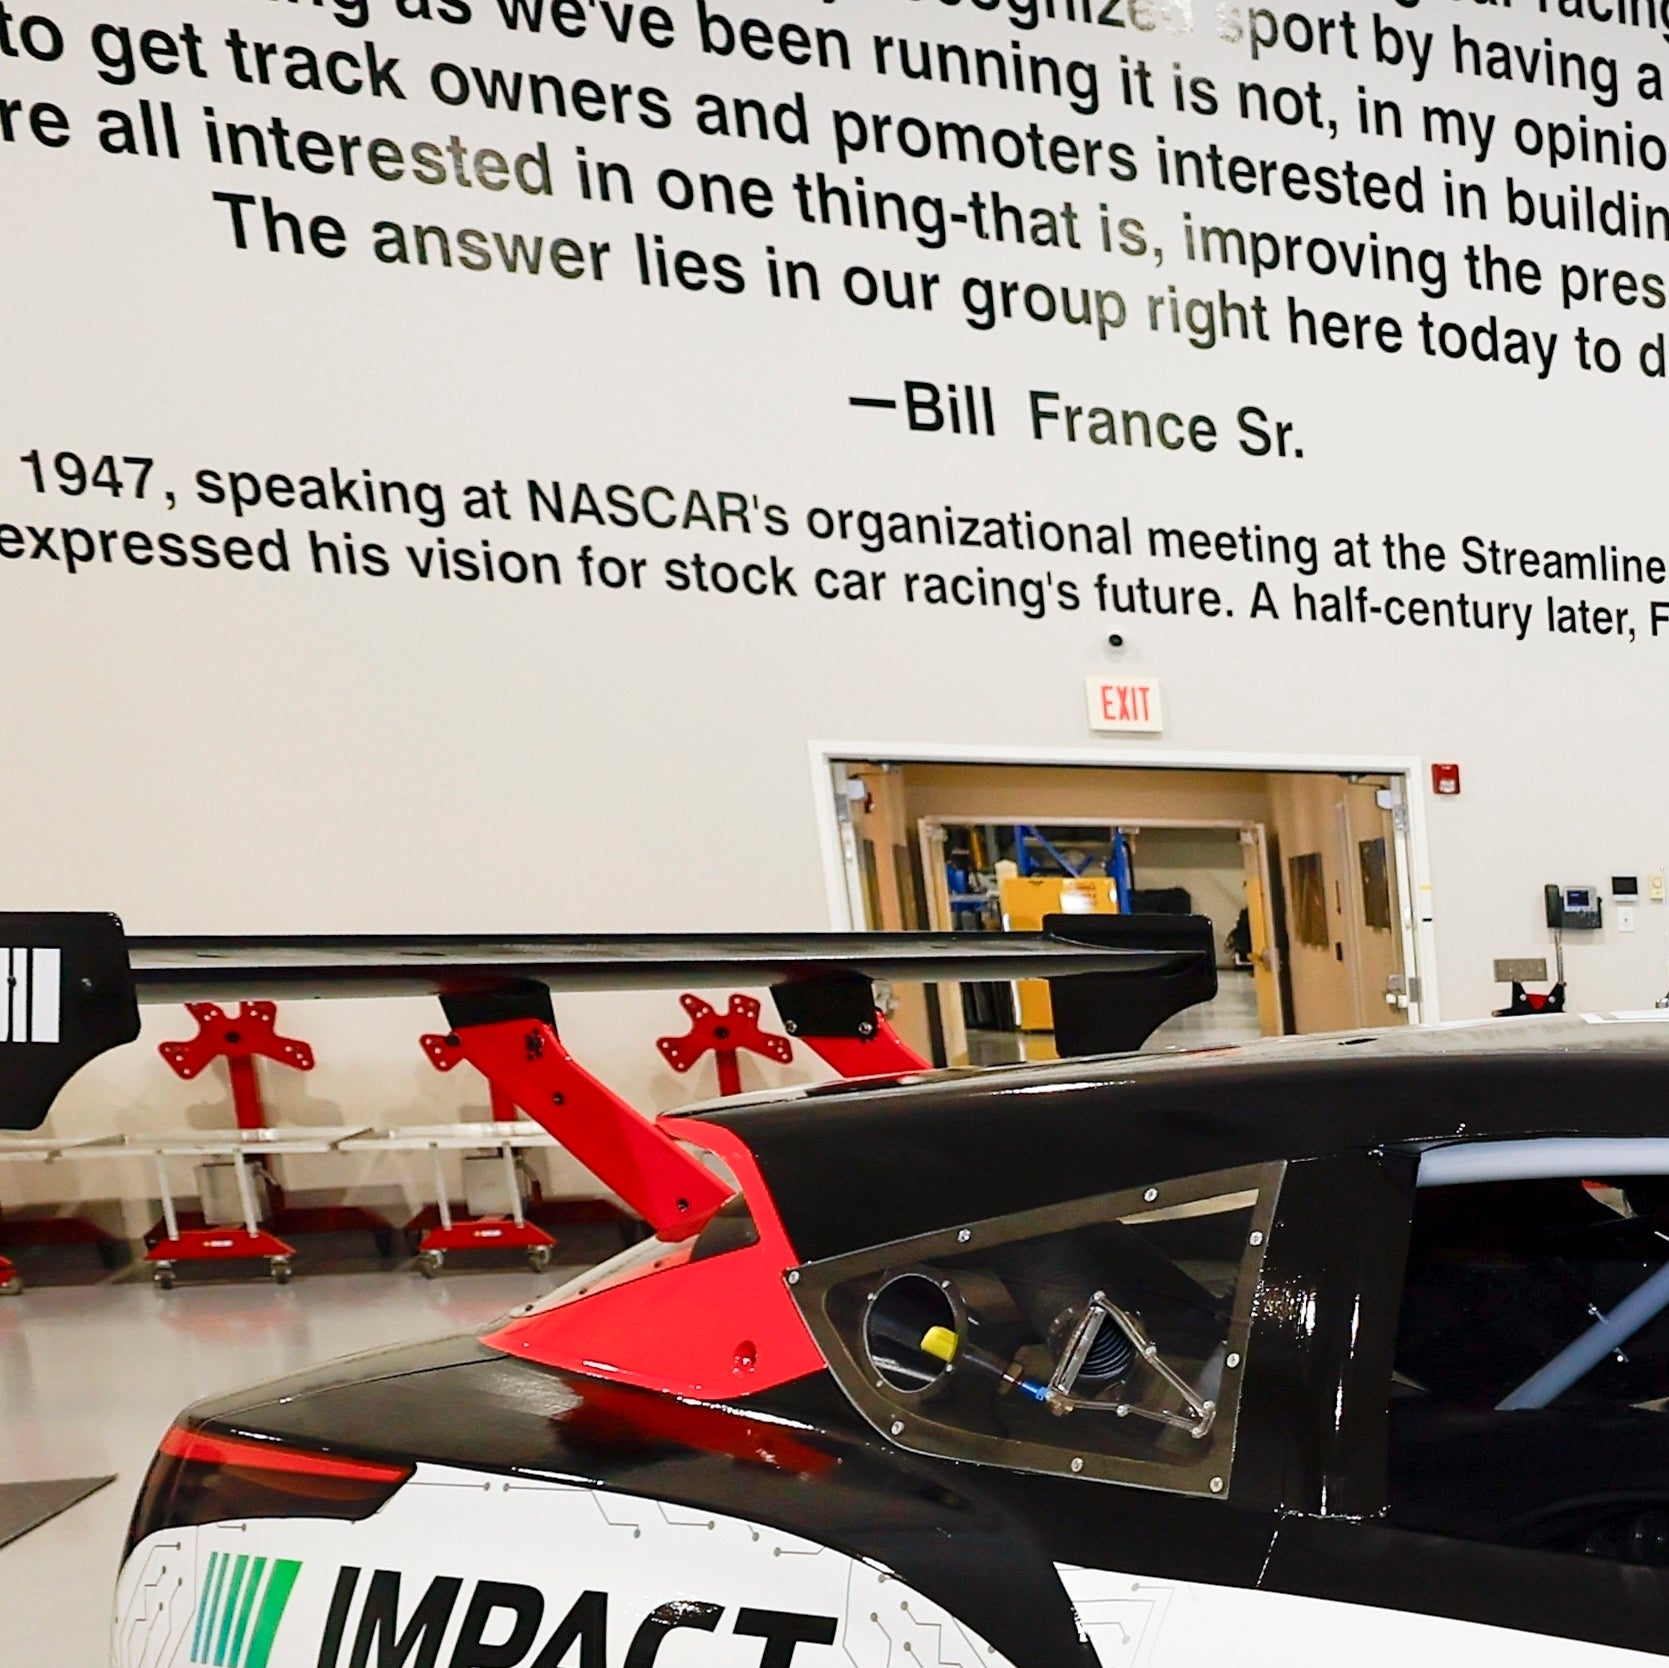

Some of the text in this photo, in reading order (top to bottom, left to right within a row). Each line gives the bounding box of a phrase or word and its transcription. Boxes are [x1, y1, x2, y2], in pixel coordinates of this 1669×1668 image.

[0, 0, 65, 63] to
[89, 21, 209, 87] get
[223, 27, 408, 101] track
[429, 61, 673, 130] owners
[694, 90, 810, 146] and
[831, 109, 1139, 183] promoters
[1155, 134, 1425, 214] interested
[1442, 168, 1489, 221] in
[394, 0, 473, 26] as
[495, 0, 676, 50] we've
[695, 0, 852, 71] been
[872, 34, 1100, 117] running
[1118, 53, 1155, 110] it
[1172, 61, 1219, 117] is
[1237, 80, 1338, 141] not,
[1356, 84, 1404, 139] in
[1421, 105, 1497, 164] my
[1213, 4, 1359, 62] sport
[1371, 11, 1435, 83] by
[1451, 23, 1619, 109] having
[1636, 62, 1665, 102] a
[96, 98, 181, 160] all
[202, 105, 554, 197] interested
[574, 144, 635, 205] in
[656, 167, 775, 220] one
[791, 171, 1082, 251] thing-that
[1098, 201, 1164, 269] is,
[1182, 211, 1448, 300] improving
[1463, 243, 1543, 296] the
[210, 190, 348, 260] The
[371, 220, 612, 282] answer
[633, 231, 746, 296] lies
[764, 244, 821, 302] in
[842, 265, 941, 312] our
[961, 276, 1127, 342] group
[1147, 284, 1271, 351] right
[1286, 295, 1404, 354] here
[1417, 310, 1559, 381] today
[1573, 325, 1622, 374] to
[1028, 389, 1218, 454] France
[1236, 405, 1304, 460] Sr.
[0, 522, 291, 575] expressed
[307, 529, 391, 578] his
[404, 535, 563, 586] vision
[576, 543, 648, 590] for
[663, 552, 799, 598] stock
[813, 567, 888, 602] car
[903, 565, 1081, 621] racing's
[1092, 572, 1234, 619] future.
[1249, 580, 1281, 621] A
[1292, 581, 1534, 642] half-century
[1546, 595, 1636, 644] later,
[194, 466, 447, 529] speaking
[462, 479, 513, 521] at
[526, 478, 790, 537] NASCAR's
[805, 504, 1133, 556] organizational
[1147, 523, 1319, 577] meeting
[1333, 531, 1372, 569] at
[1381, 531, 1447, 573] the
[1461, 534, 1667, 585] Streamline
[1100, 685, 1150, 722] EXIT
